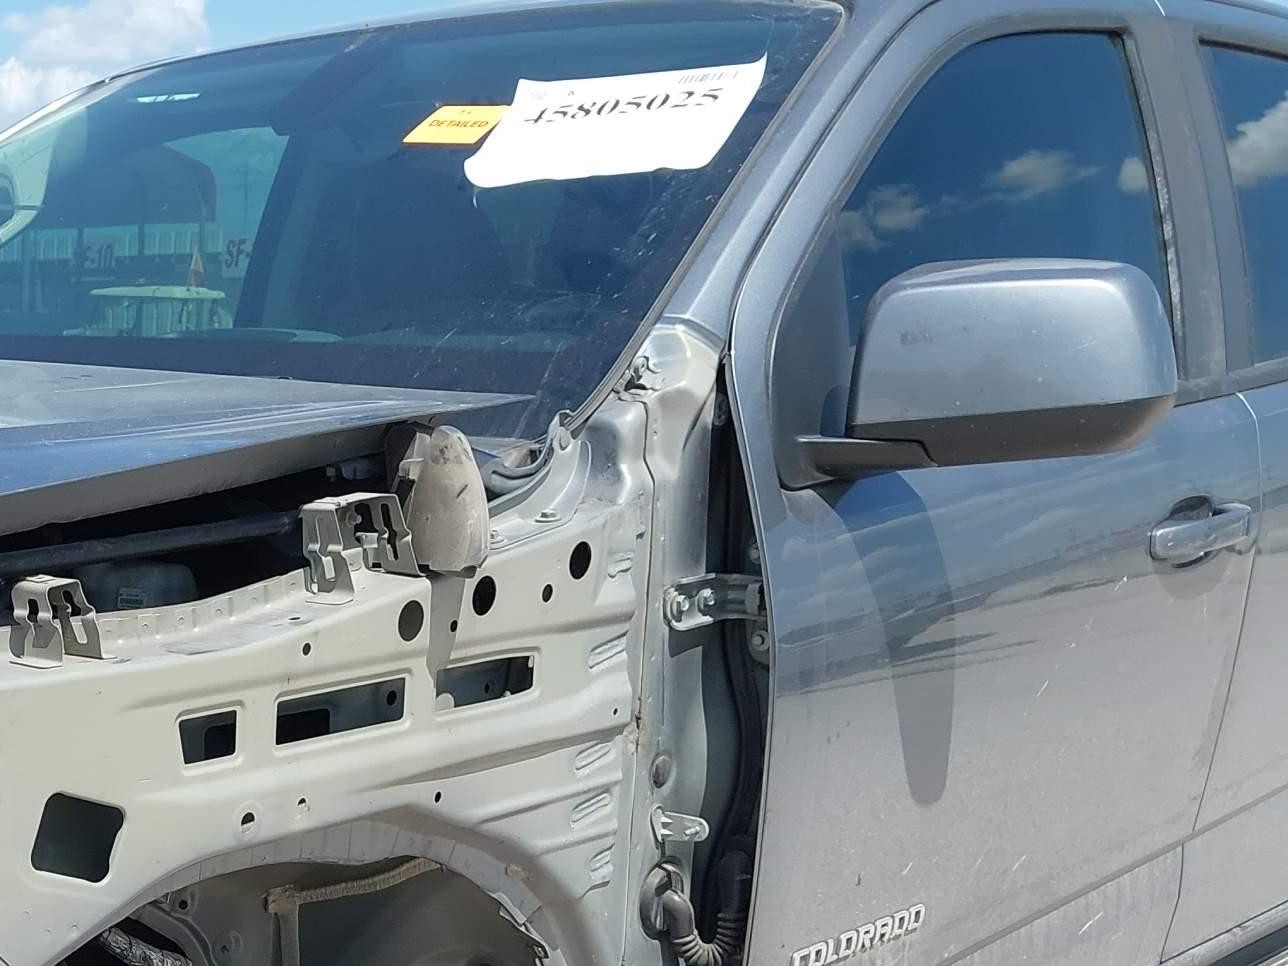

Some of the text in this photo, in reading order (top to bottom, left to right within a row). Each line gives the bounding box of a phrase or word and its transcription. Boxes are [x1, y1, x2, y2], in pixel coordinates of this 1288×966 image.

[523, 87, 725, 125] 45805025
[428, 119, 490, 129] DETAILED
[224, 238, 250, 269] SF-
